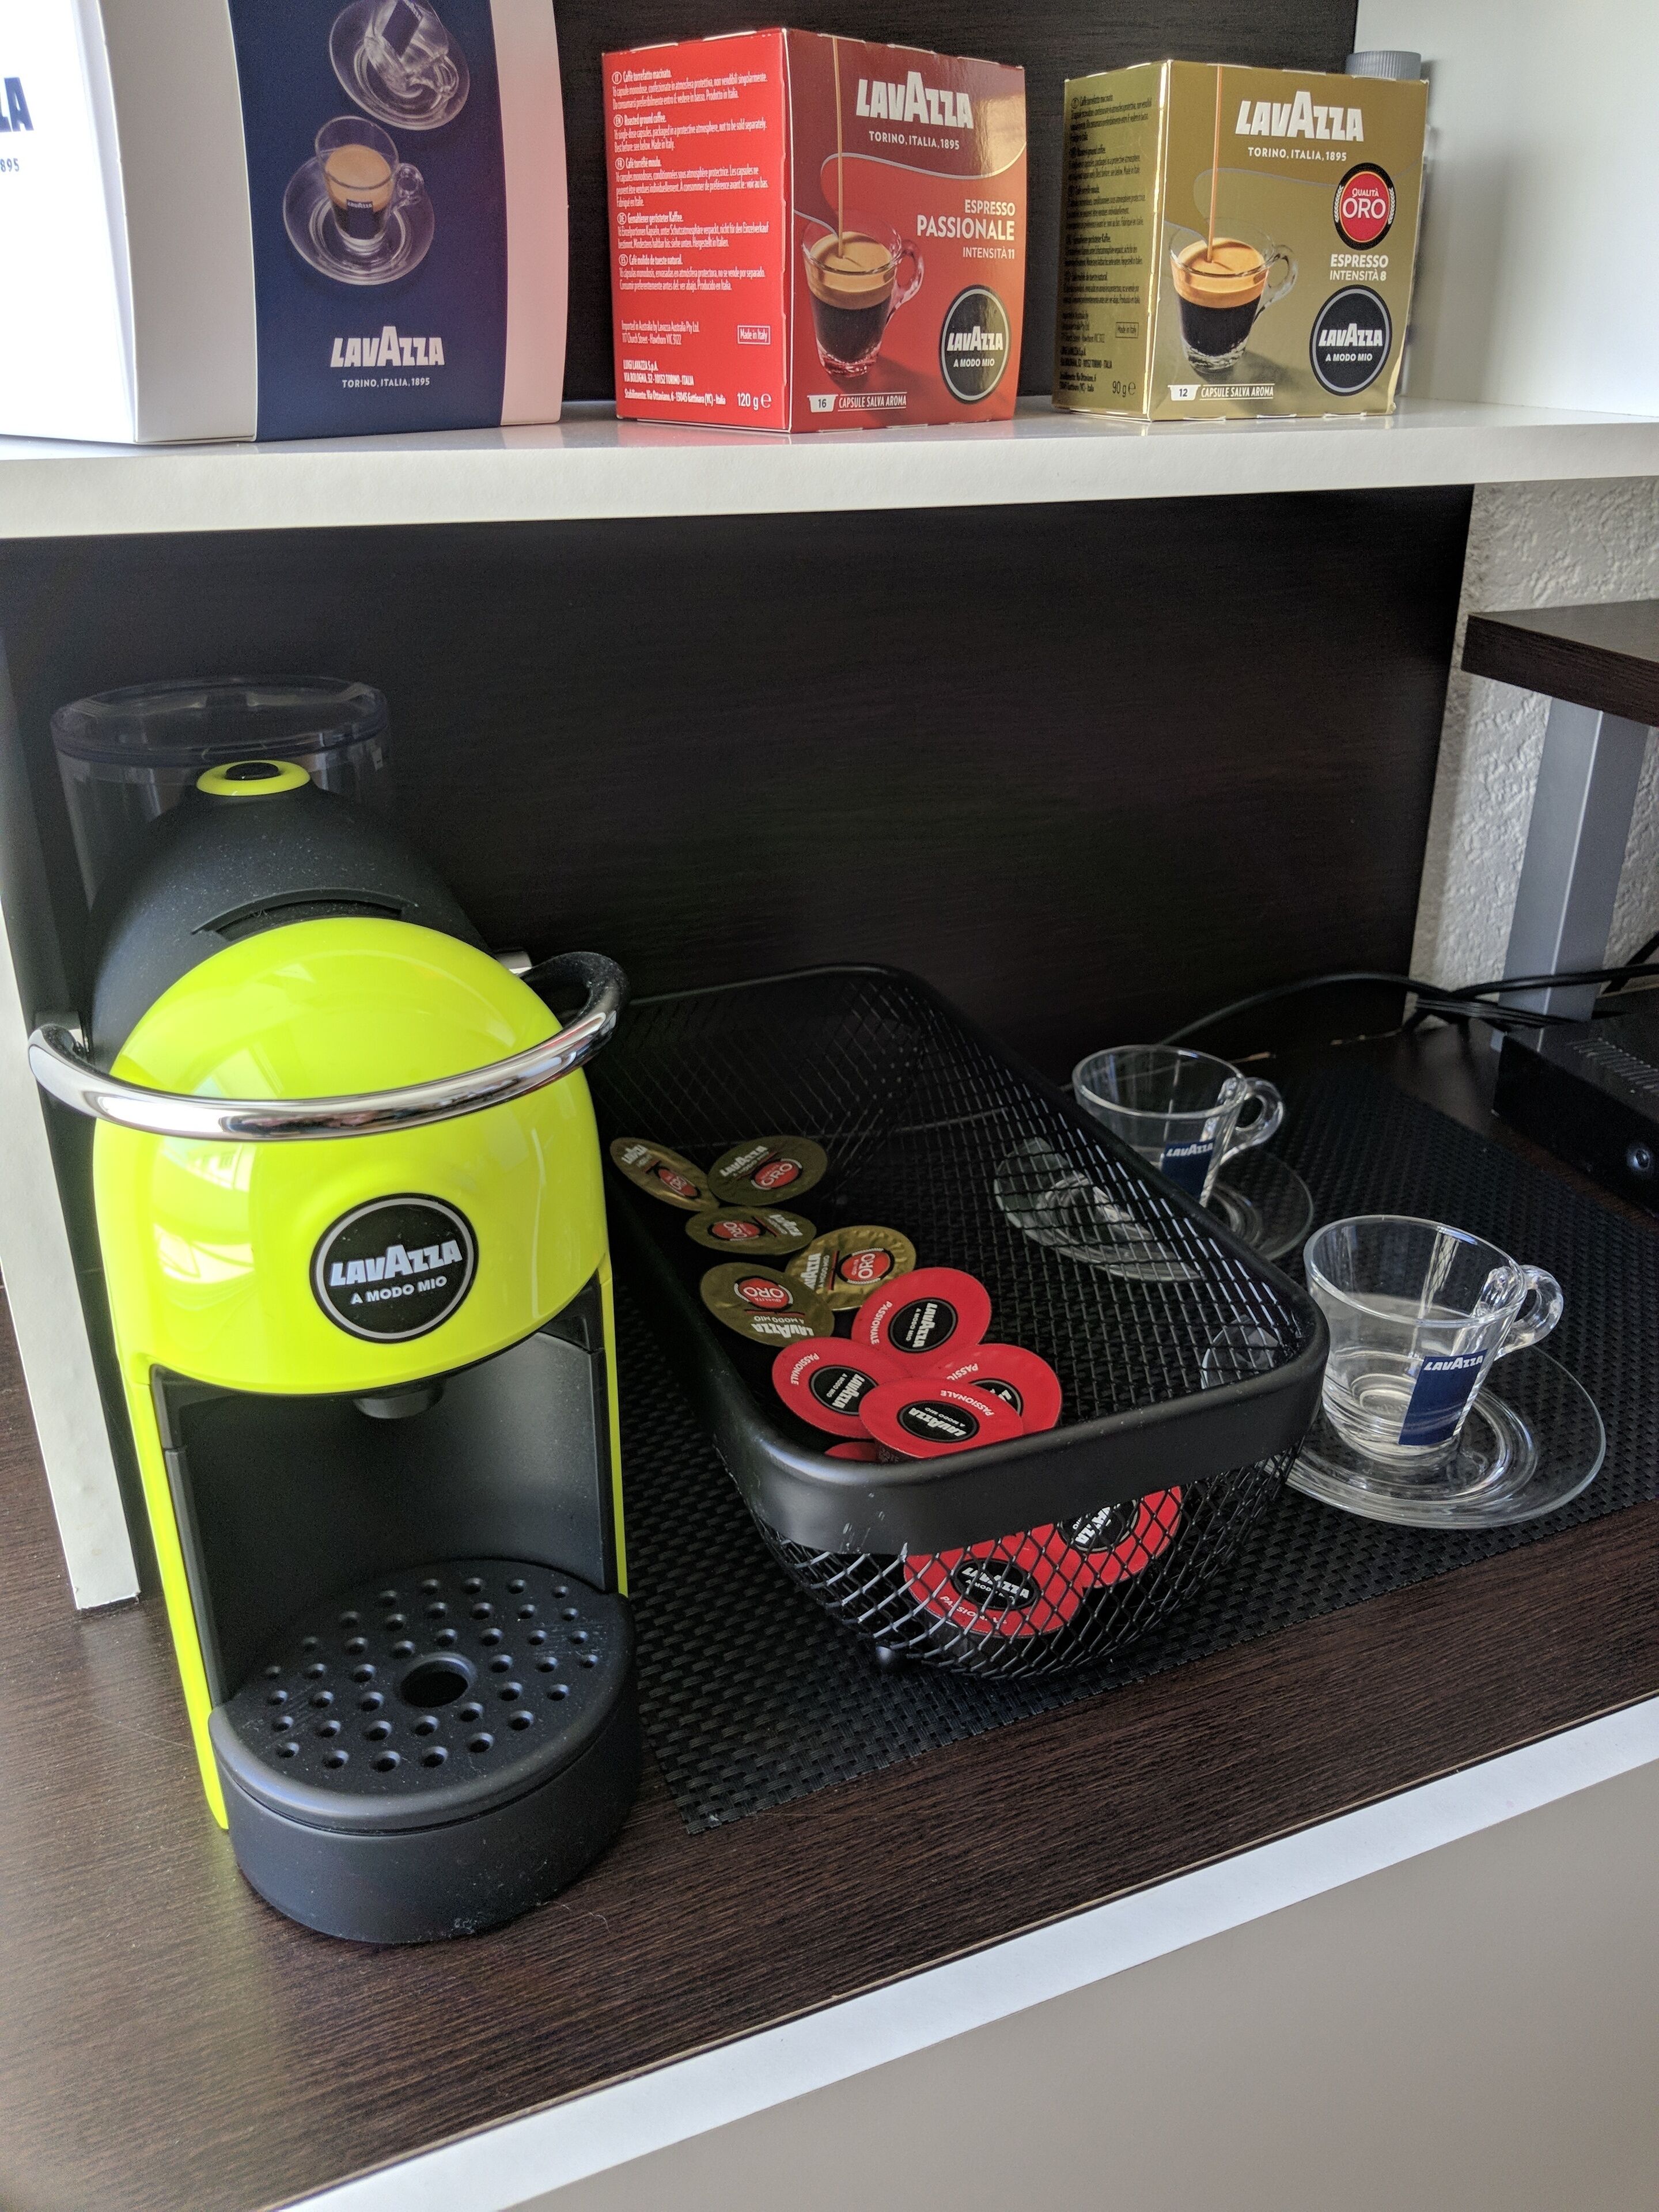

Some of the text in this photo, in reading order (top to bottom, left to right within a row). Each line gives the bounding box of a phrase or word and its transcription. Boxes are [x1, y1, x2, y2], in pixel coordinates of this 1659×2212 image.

[855, 71, 974, 130] LAVAZZA
[624, 114, 639, 126] Roasted
[639, 112, 653, 127] ground
[653, 111, 666, 123] coffee.
[737, 118, 745, 130] sold
[1235, 90, 1364, 142] LAVAZZA
[940, 138, 960, 150] 1895
[1325, 151, 1347, 162] 1895
[1352, 187, 1379, 198] QUALITÀ
[964, 199, 1016, 217] ESPRESSO
[1342, 198, 1387, 220] ORO
[916, 215, 1015, 241] PASSIONALE
[963, 245, 1007, 259] INTENSITÀ
[1330, 253, 1389, 268] ESPRESSO
[1330, 268, 1386, 281] INTENSITÀ 8
[740, 328, 768, 342] Made in Italy
[946, 325, 1003, 351] LAVAZZA
[1318, 323, 1383, 346] LAVAZZA
[330, 326, 445, 368] LAVAZZA
[953, 357, 995, 368] A MODO MIO
[1325, 353, 1373, 362] A MODO MIO
[411, 377, 430, 386] 1895
[1112, 381, 1120, 394] 90
[1122, 384, 1126, 397] g
[1179, 388, 1188, 397] 12
[1201, 385, 1274, 398] CAPSULE SALVA AROMA
[737, 393, 751, 407] 120
[753, 396, 759, 410] g
[818, 399, 827, 408] 16
[839, 394, 907, 408] CAPSULE SALVA AROMA
[1166, 1142, 1214, 1157] LAVAZZA
[761, 1163, 793, 1186] ORO
[330, 1240, 463, 1286] LAVAZZA
[858, 1253, 876, 1279] ORO
[350, 1275, 448, 1305] A MODO MIO
[743, 1286, 784, 1298] ORO
[870, 1301, 893, 1345] PASSIONALE
[910, 1313, 920, 1330] MODO
[912, 1302, 938, 1347] LAVAZZA
[751, 1323, 814, 1338] LAVAZZA
[906, 1330, 914, 1342] MIO
[790, 1353, 820, 1385] PASSIONALE
[1423, 1355, 1483, 1371] LAVAZZA
[832, 1376, 846, 1390] MODO
[832, 1373, 865, 1408] LAVAZZA
[826, 1388, 836, 1398] MIO
[940, 1390, 995, 1416] PASSIONALE
[908, 1407, 967, 1437] LAVAZZA
